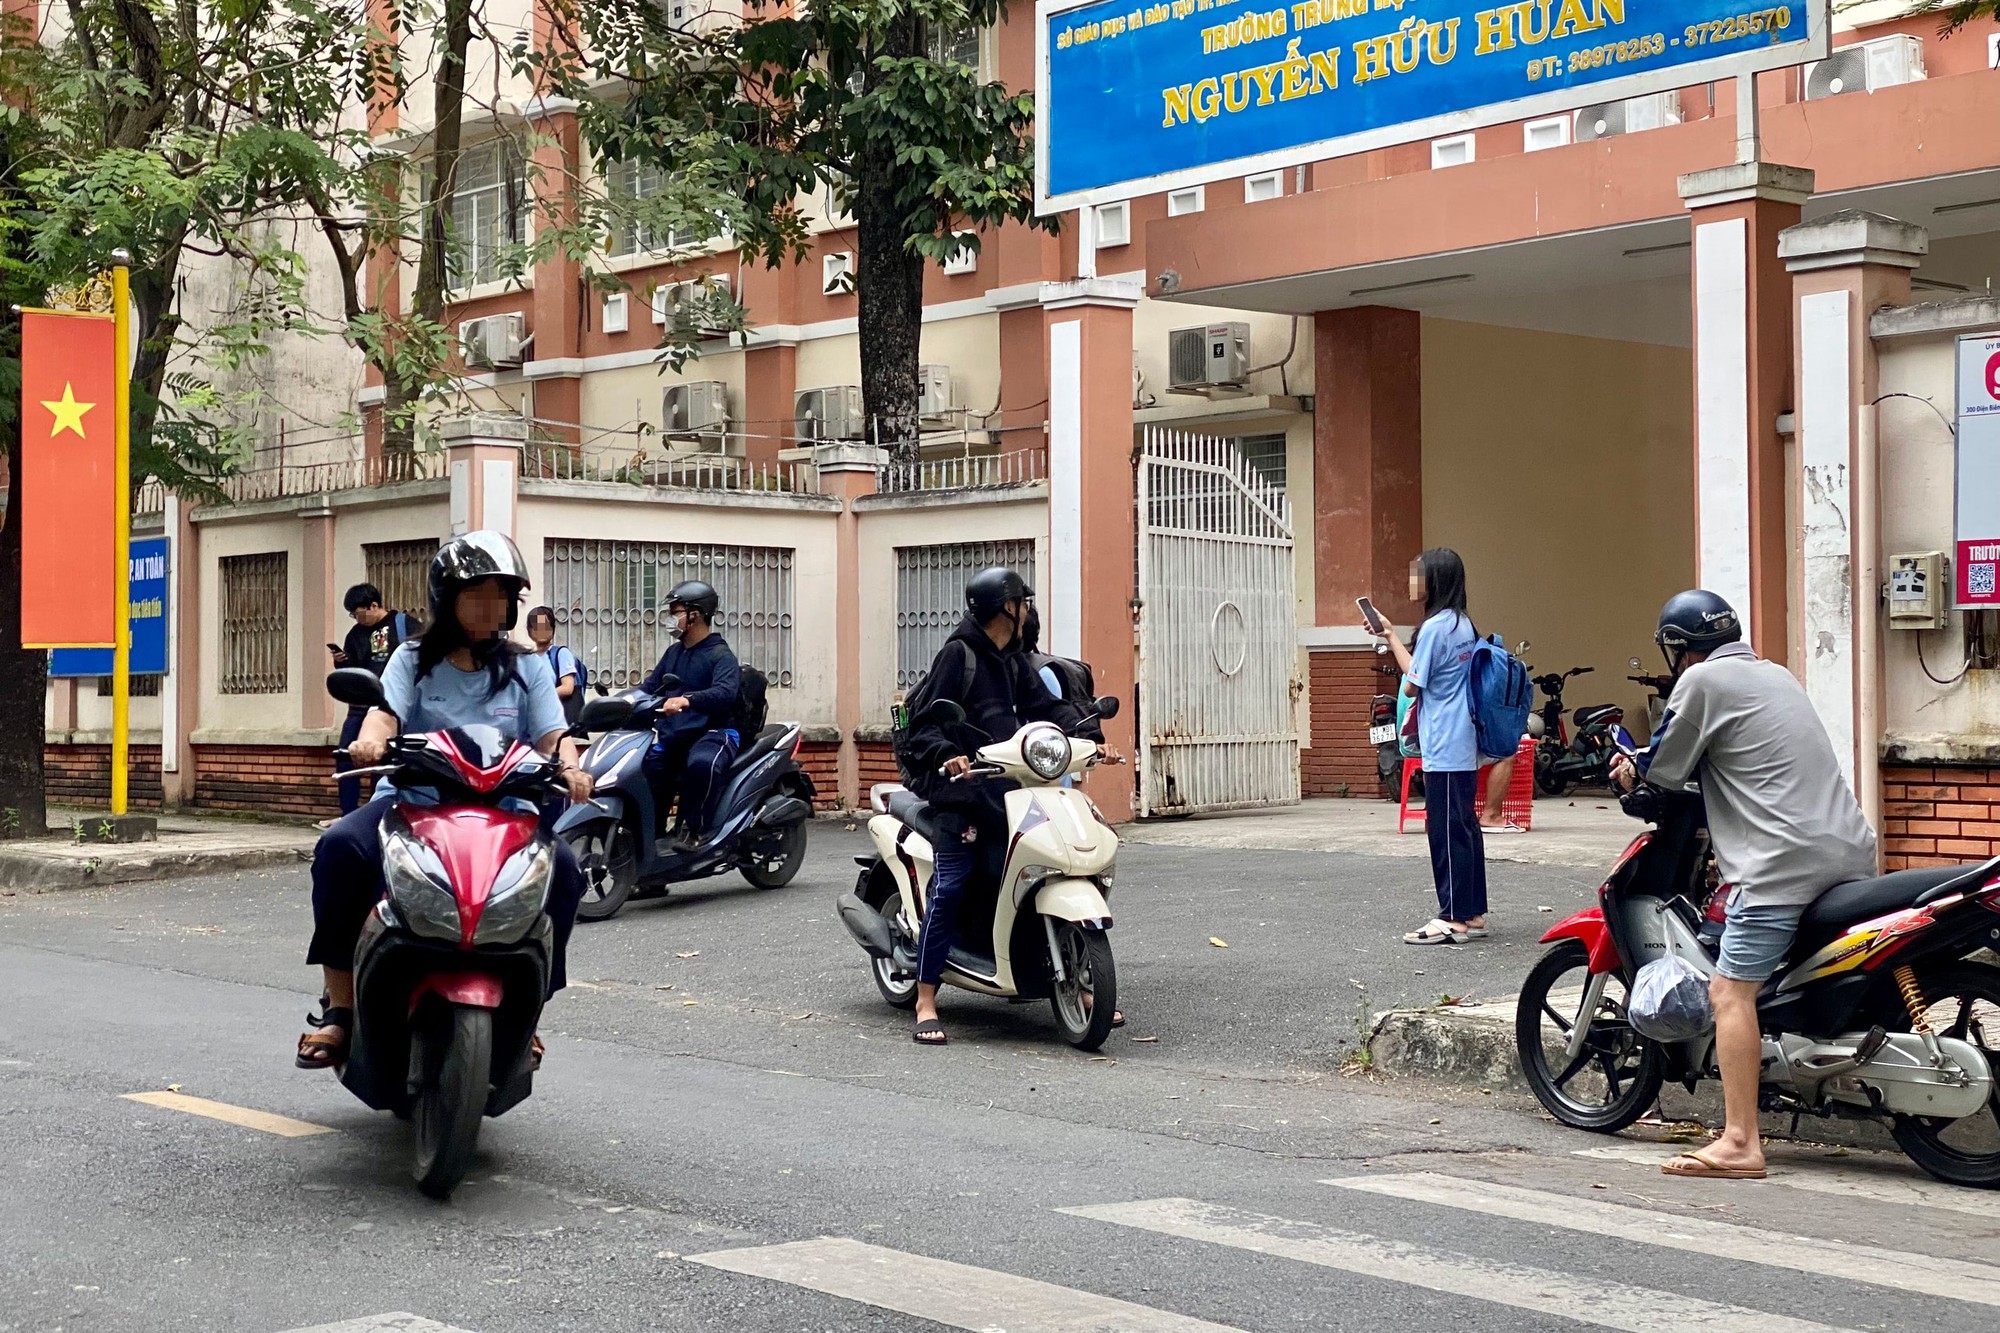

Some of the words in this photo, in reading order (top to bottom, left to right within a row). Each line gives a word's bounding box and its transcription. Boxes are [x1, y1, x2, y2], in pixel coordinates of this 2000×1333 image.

[1073, 22, 1100, 45] GIÁO
[1101, 16, 1126, 39] DỤC
[1127, 9, 1143, 31] VÀ
[1144, 3, 1170, 26] ĐÀO
[1201, 8, 1287, 54] TRƯỜNG
[1527, 55, 1563, 82] ĐT:
[1568, 32, 1666, 73] 38978253
[1684, 5, 1791, 48] 37225570
[1162, 36, 1341, 128] NGUYỄN
[1353, 15, 1460, 84] HỮU
[134, 558, 145, 581] AN
[145, 551, 164, 580] TOÀN
